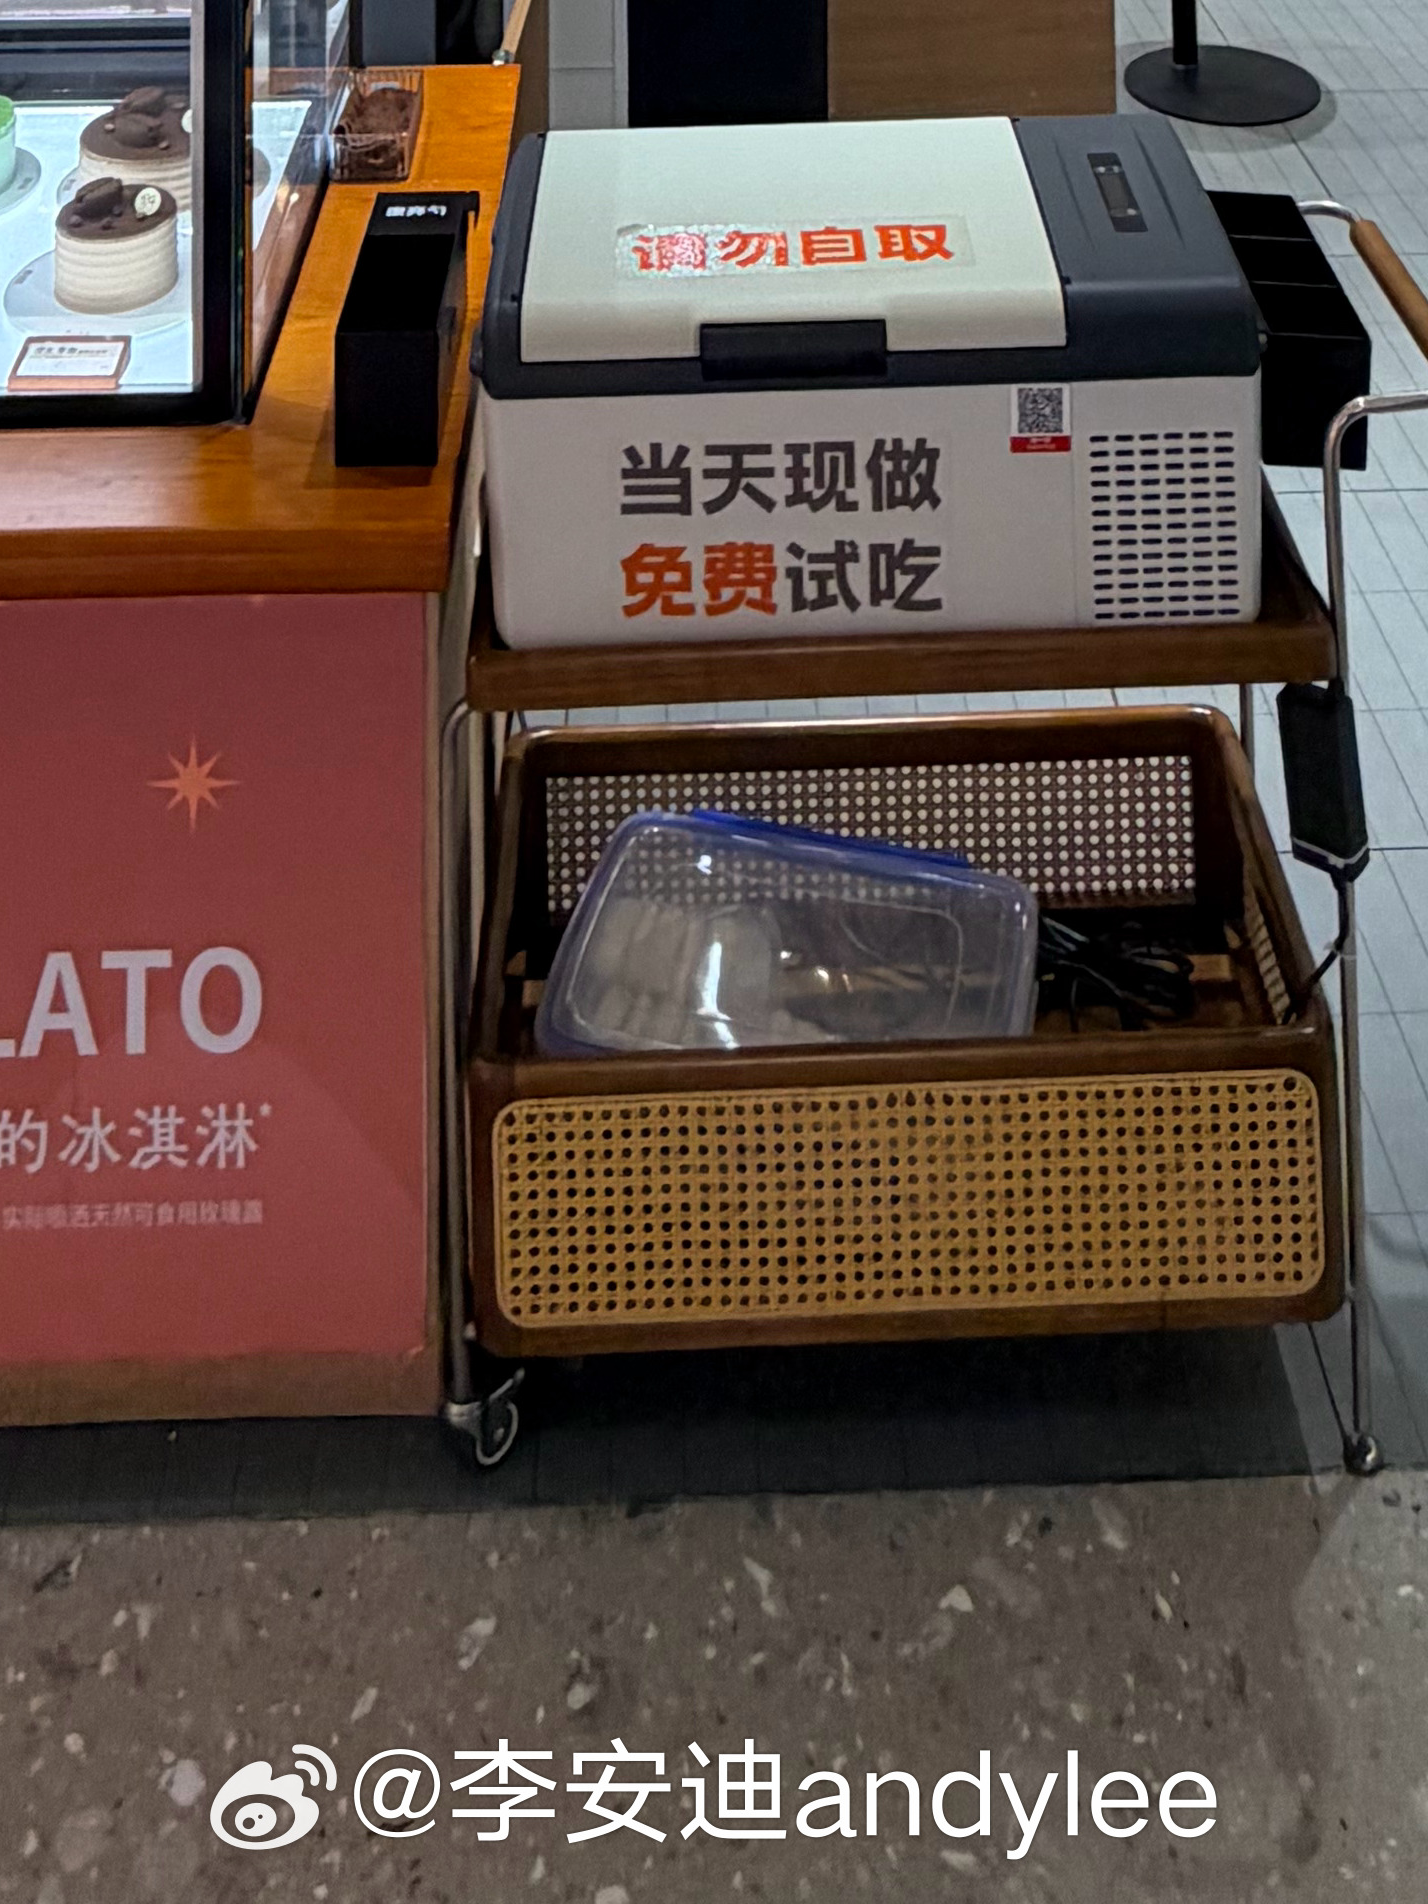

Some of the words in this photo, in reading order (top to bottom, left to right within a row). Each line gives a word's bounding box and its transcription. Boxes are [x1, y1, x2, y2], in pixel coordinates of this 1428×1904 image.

[633, 223, 954, 272] 请勿自取
[619, 437, 942, 516] 当天现做
[619, 538, 943, 618] 免费试吃
